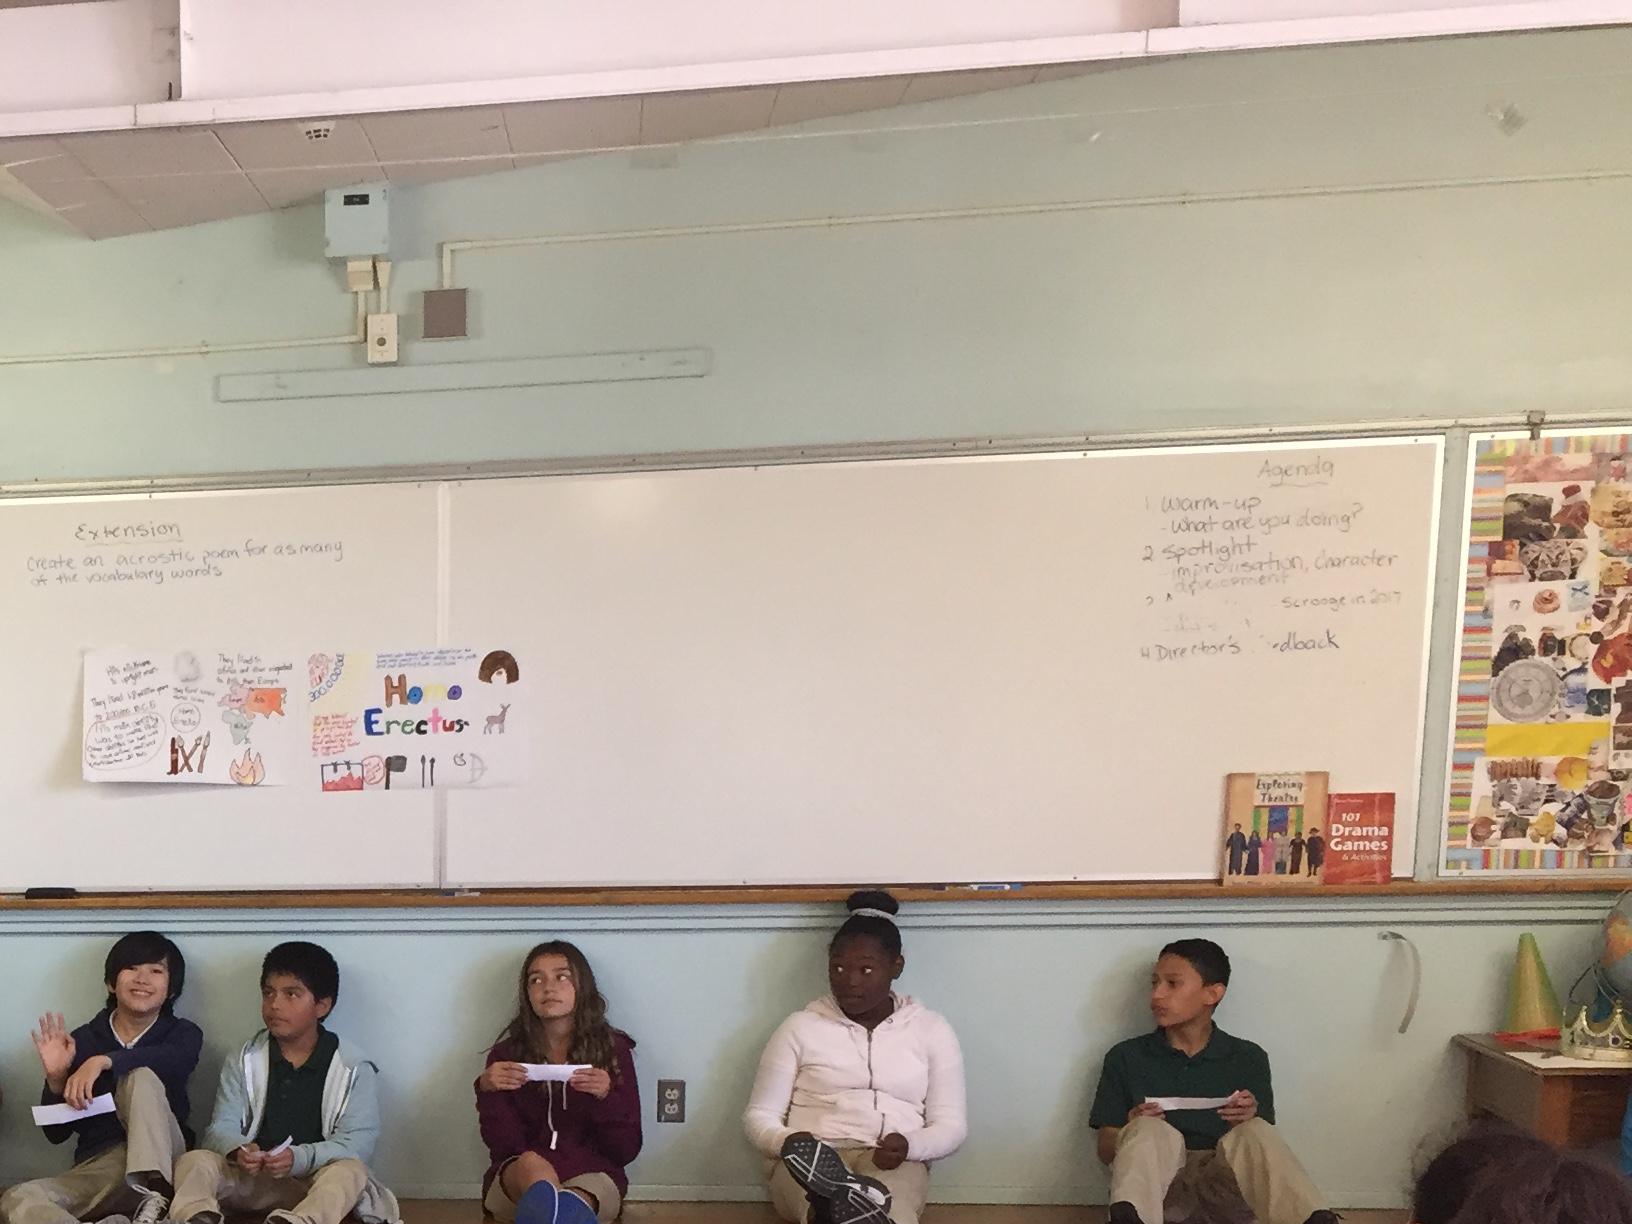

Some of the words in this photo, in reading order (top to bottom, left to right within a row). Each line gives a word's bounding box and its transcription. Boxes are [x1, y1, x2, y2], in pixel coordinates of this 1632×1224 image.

[1257, 456, 1335, 487] Agenda
[1222, 518, 1255, 531] are
[1259, 515, 1290, 535] you
[1296, 502, 1364, 533] doing?
[74, 521, 182, 541] Extension
[82, 555, 104, 567] an
[115, 548, 196, 566] acrostic
[202, 550, 240, 565] poem
[243, 538, 268, 558] for
[273, 546, 297, 556] as
[299, 540, 344, 562] many
[30, 573, 50, 587] of
[55, 573, 80, 585] the
[85, 567, 165, 585] vocabulary
[170, 564, 224, 579] words
[383, 673, 464, 708] Homo
[363, 707, 470, 736] Erectus
[1256, 778, 1304, 792] Exploring
[1260, 793, 1300, 804] Theatre
[1341, 812, 1362, 822] 101
[1331, 823, 1389, 837] Drama
[1329, 837, 1389, 851] Games
